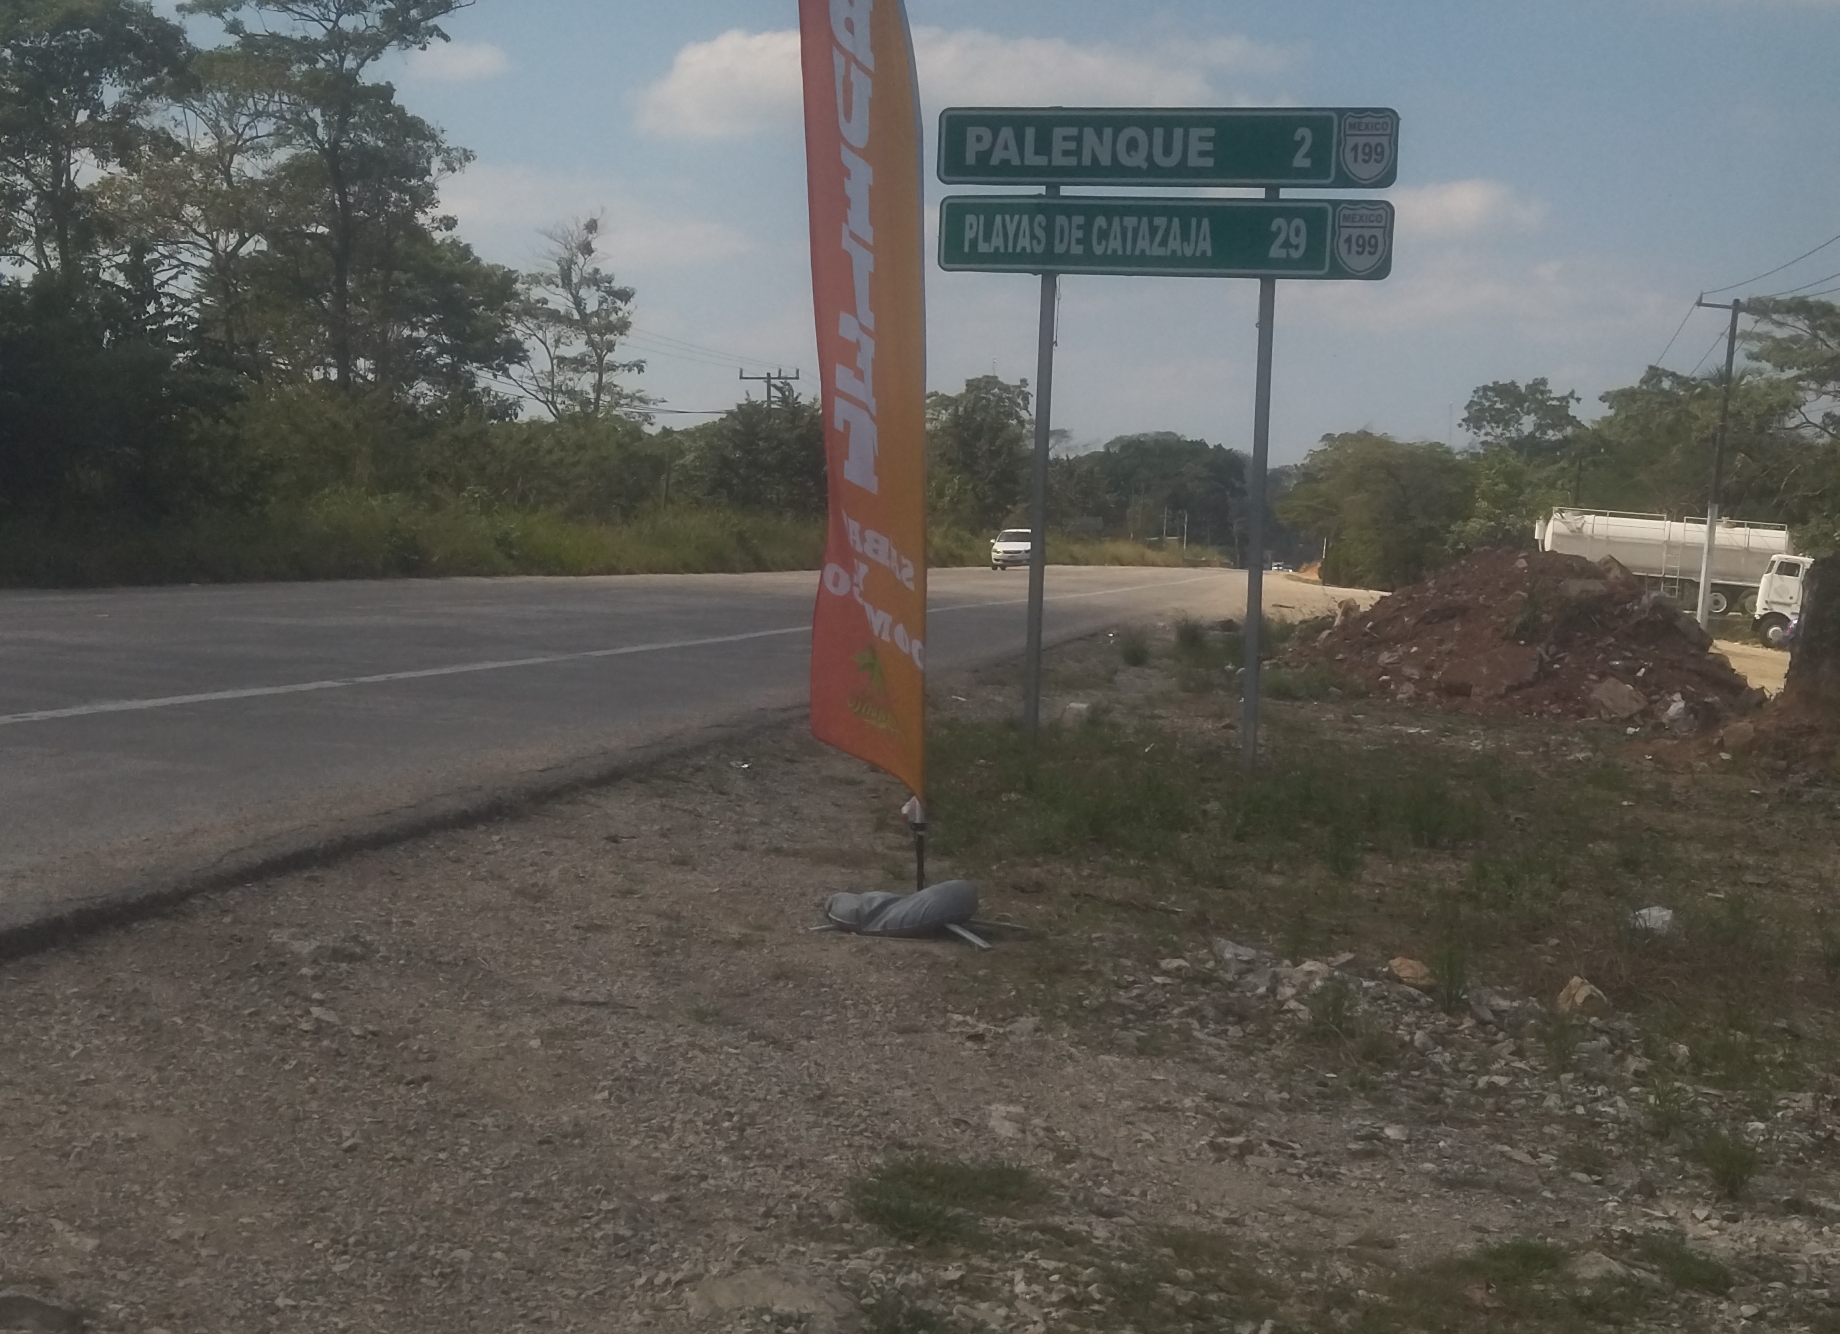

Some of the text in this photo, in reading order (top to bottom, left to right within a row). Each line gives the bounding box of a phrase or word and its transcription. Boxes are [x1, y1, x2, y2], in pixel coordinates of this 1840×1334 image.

[1348, 121, 1389, 132] MEXICO
[964, 125, 1313, 170] PALENQUE 2
[1350, 141, 1385, 164] 199
[1342, 213, 1383, 225] MEXICO
[963, 213, 1307, 259] PLAYAS DE CATAZAJA 29
[1343, 233, 1379, 256] 199
